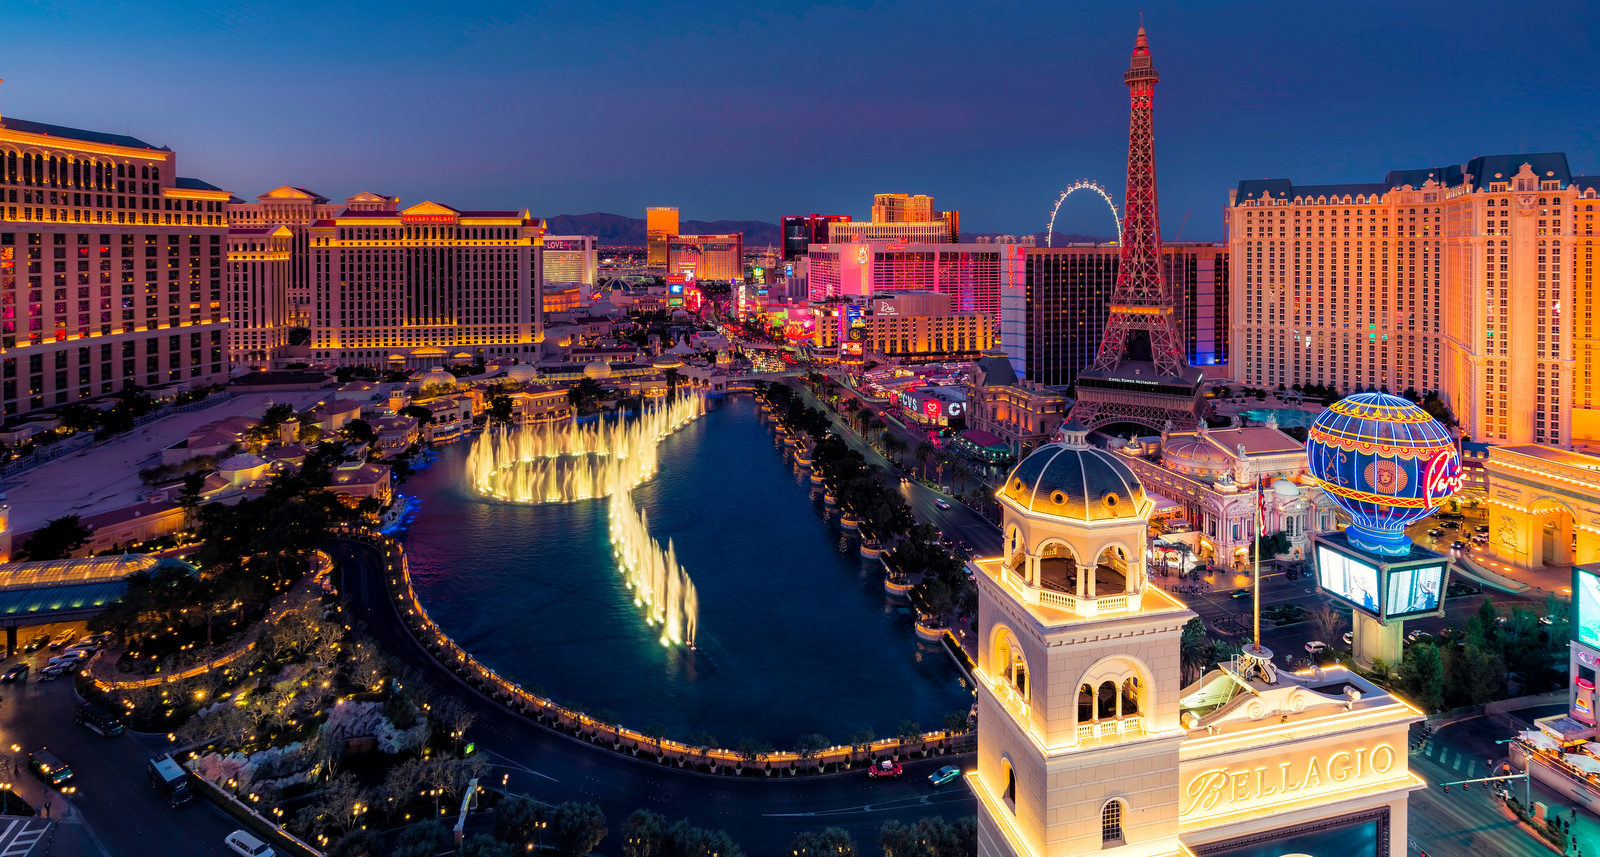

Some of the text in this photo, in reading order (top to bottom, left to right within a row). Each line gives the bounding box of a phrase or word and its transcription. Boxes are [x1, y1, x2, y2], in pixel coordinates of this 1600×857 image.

[547, 241, 564, 249] LOVE
[902, 392, 918, 412] CVS
[1424, 450, 1468, 509] Paris
[1179, 744, 1396, 816] BELLAGIO
